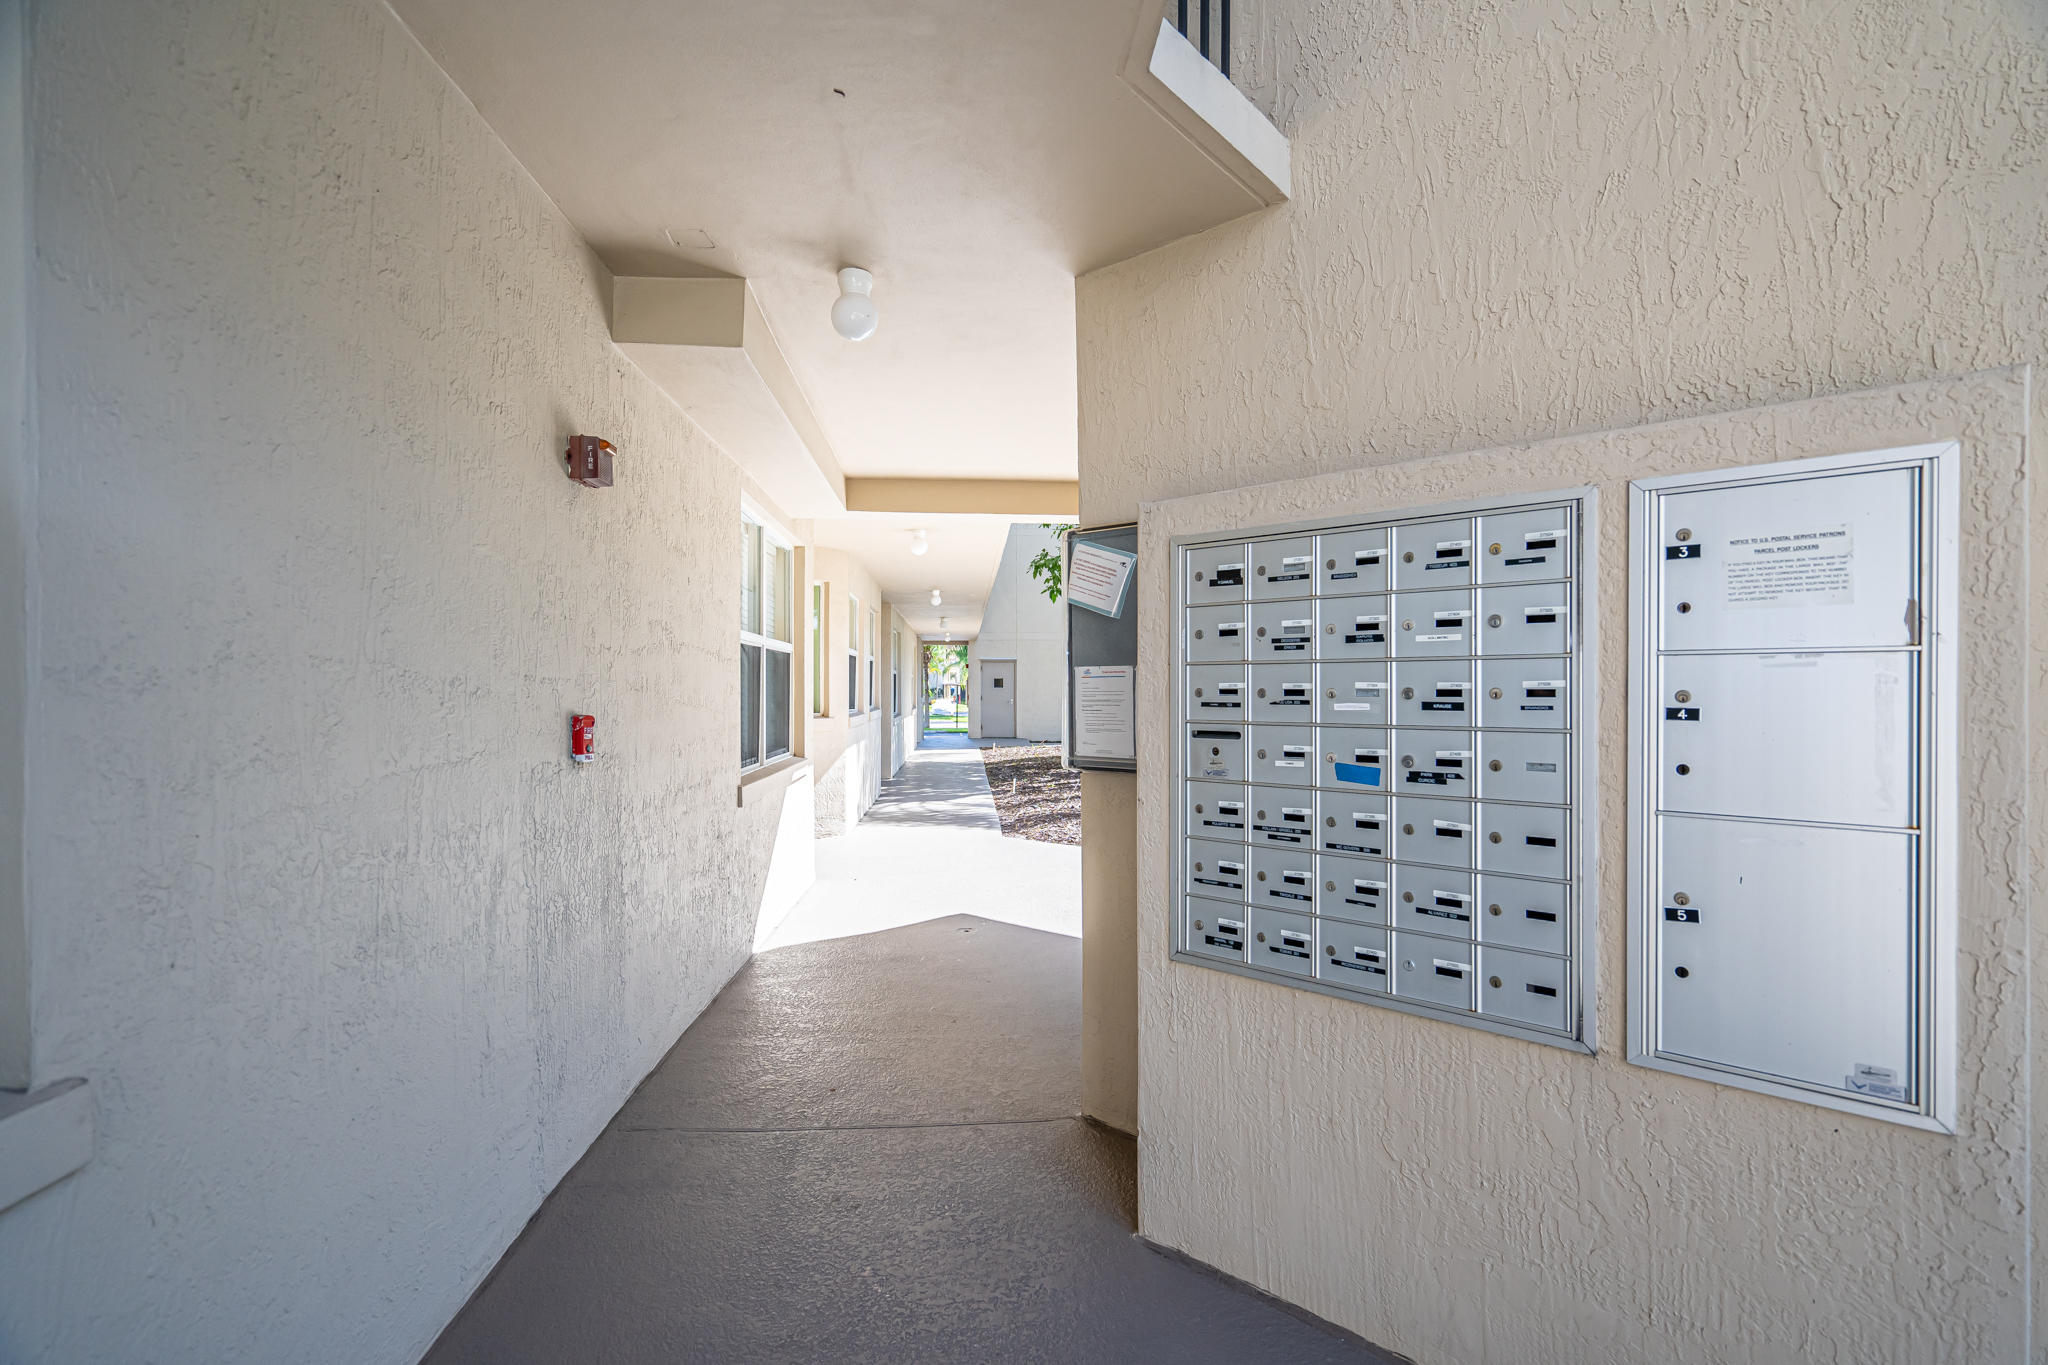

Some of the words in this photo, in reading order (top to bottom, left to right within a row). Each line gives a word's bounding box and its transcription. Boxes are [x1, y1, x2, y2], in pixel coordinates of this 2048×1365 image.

[1678, 546, 1688, 558] 3
[1793, 544, 1819, 552] LOCKERS
[1677, 708, 1688, 720] 4
[1677, 909, 1687, 921] 5
